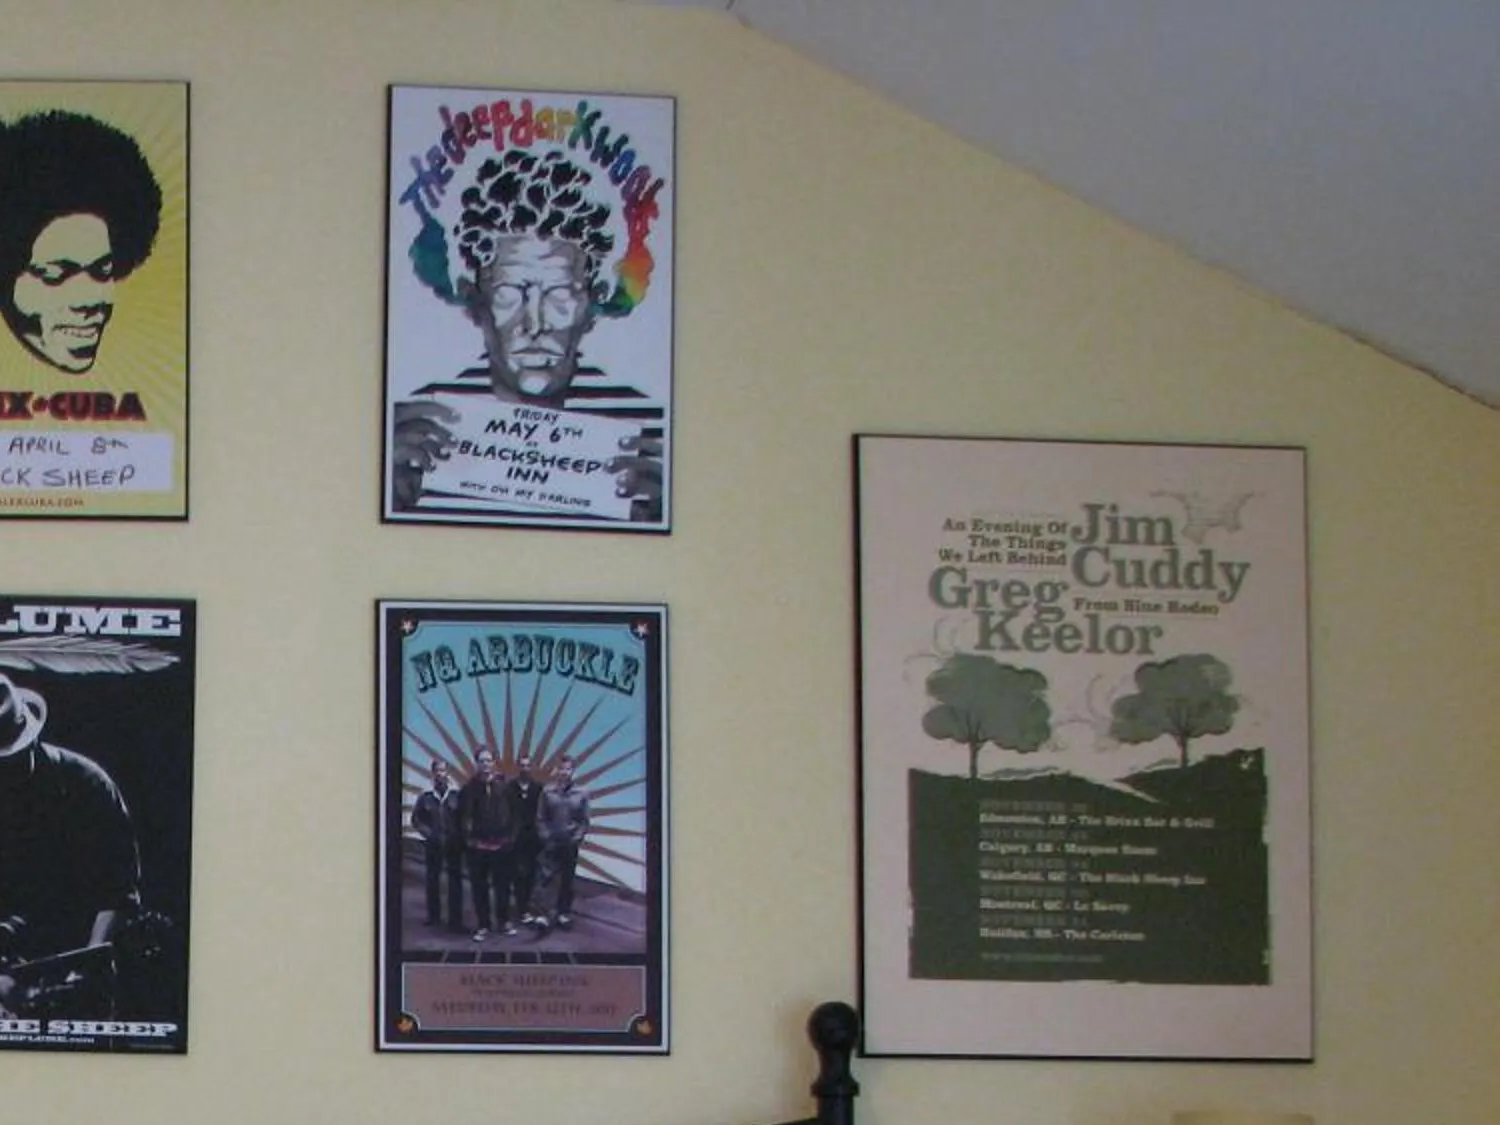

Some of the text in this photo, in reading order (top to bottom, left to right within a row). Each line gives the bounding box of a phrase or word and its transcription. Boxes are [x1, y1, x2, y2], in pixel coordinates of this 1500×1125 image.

[438, 98, 515, 165] deep
[509, 98, 602, 150] dark
[50, 391, 148, 421] CUBA
[512, 406, 561, 426] FRIDAY
[483, 419, 584, 444] MAY 6TH
[8, 435, 71, 456] APRIL
[40, 464, 136, 489] SHEEP
[506, 465, 551, 486] INN
[941, 518, 1071, 538] An Evening Of
[1070, 502, 1177, 547] Jim
[967, 533, 1068, 553] The Things
[938, 548, 1068, 568] We Left Behind
[1071, 545, 1252, 604] Cuddy
[928, 564, 1070, 625] Greg
[1073, 596, 1120, 613] From
[972, 609, 1165, 657] Keelor
[465, 633, 641, 697] ARBUCKLE
[47, 1018, 179, 1037] SHEEP
